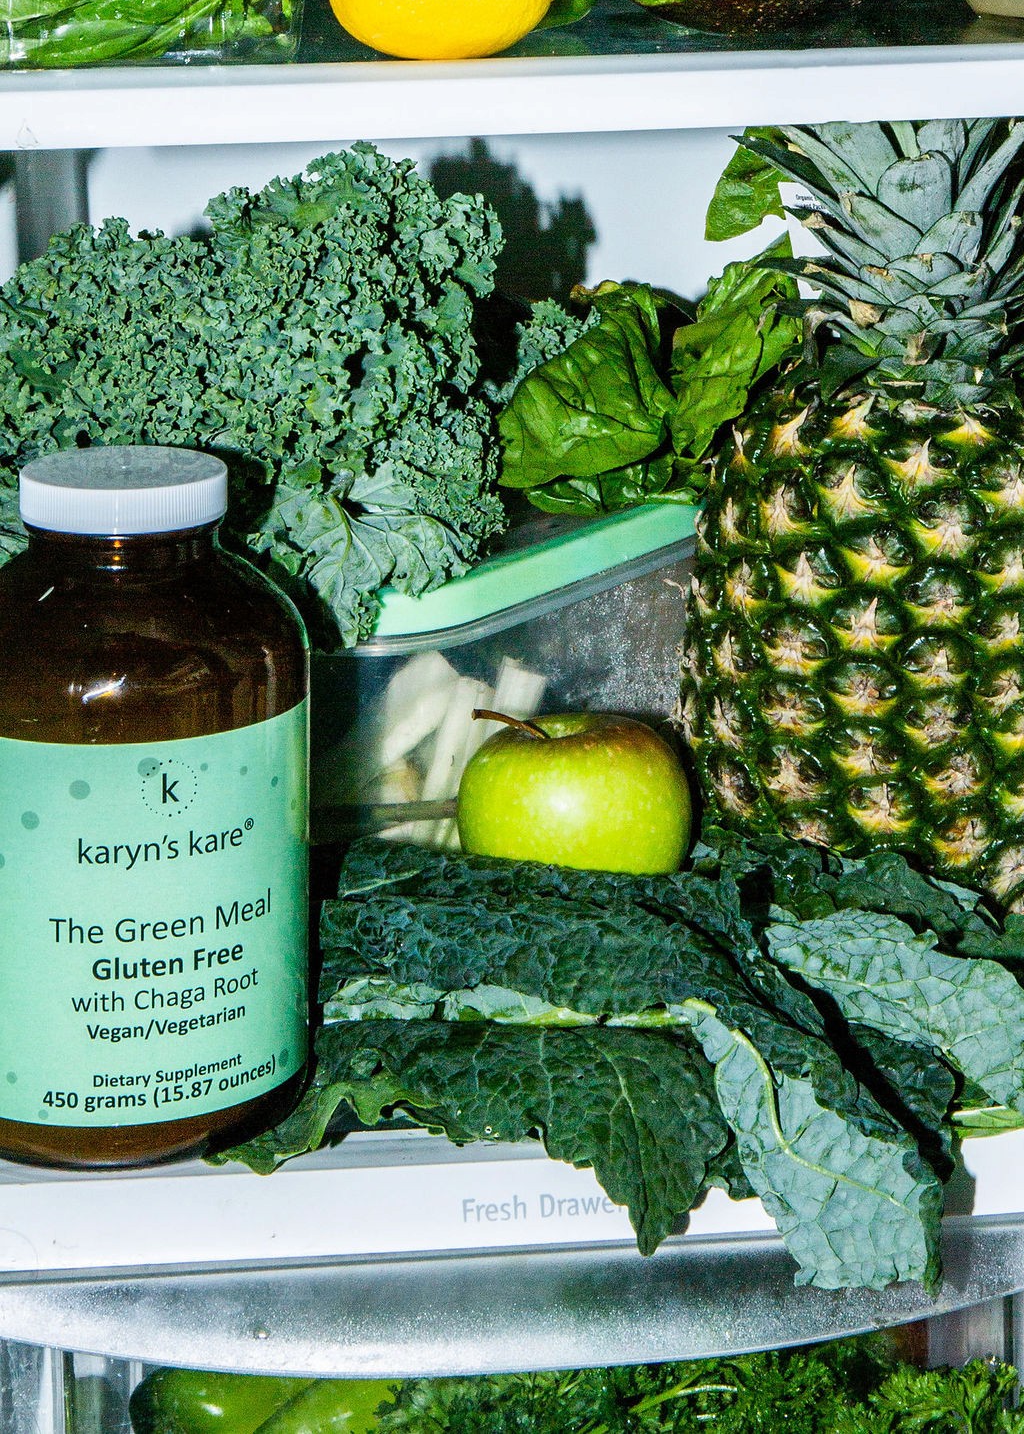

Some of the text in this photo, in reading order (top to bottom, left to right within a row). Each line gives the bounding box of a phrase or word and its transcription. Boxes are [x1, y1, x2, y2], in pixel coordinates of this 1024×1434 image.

[49, 888, 272, 944] The Green Meal
[92, 944, 244, 981] Gluten Free
[72, 967, 259, 1015] with Chaga Root
[87, 1004, 246, 1043] Vegan/Vegetarian
[42, 1054, 276, 1112] 450 grams (15.87 ounces)
[93, 1053, 242, 1090] Dietary Supplement
[462, 1193, 623, 1223] Fresh Drawe
